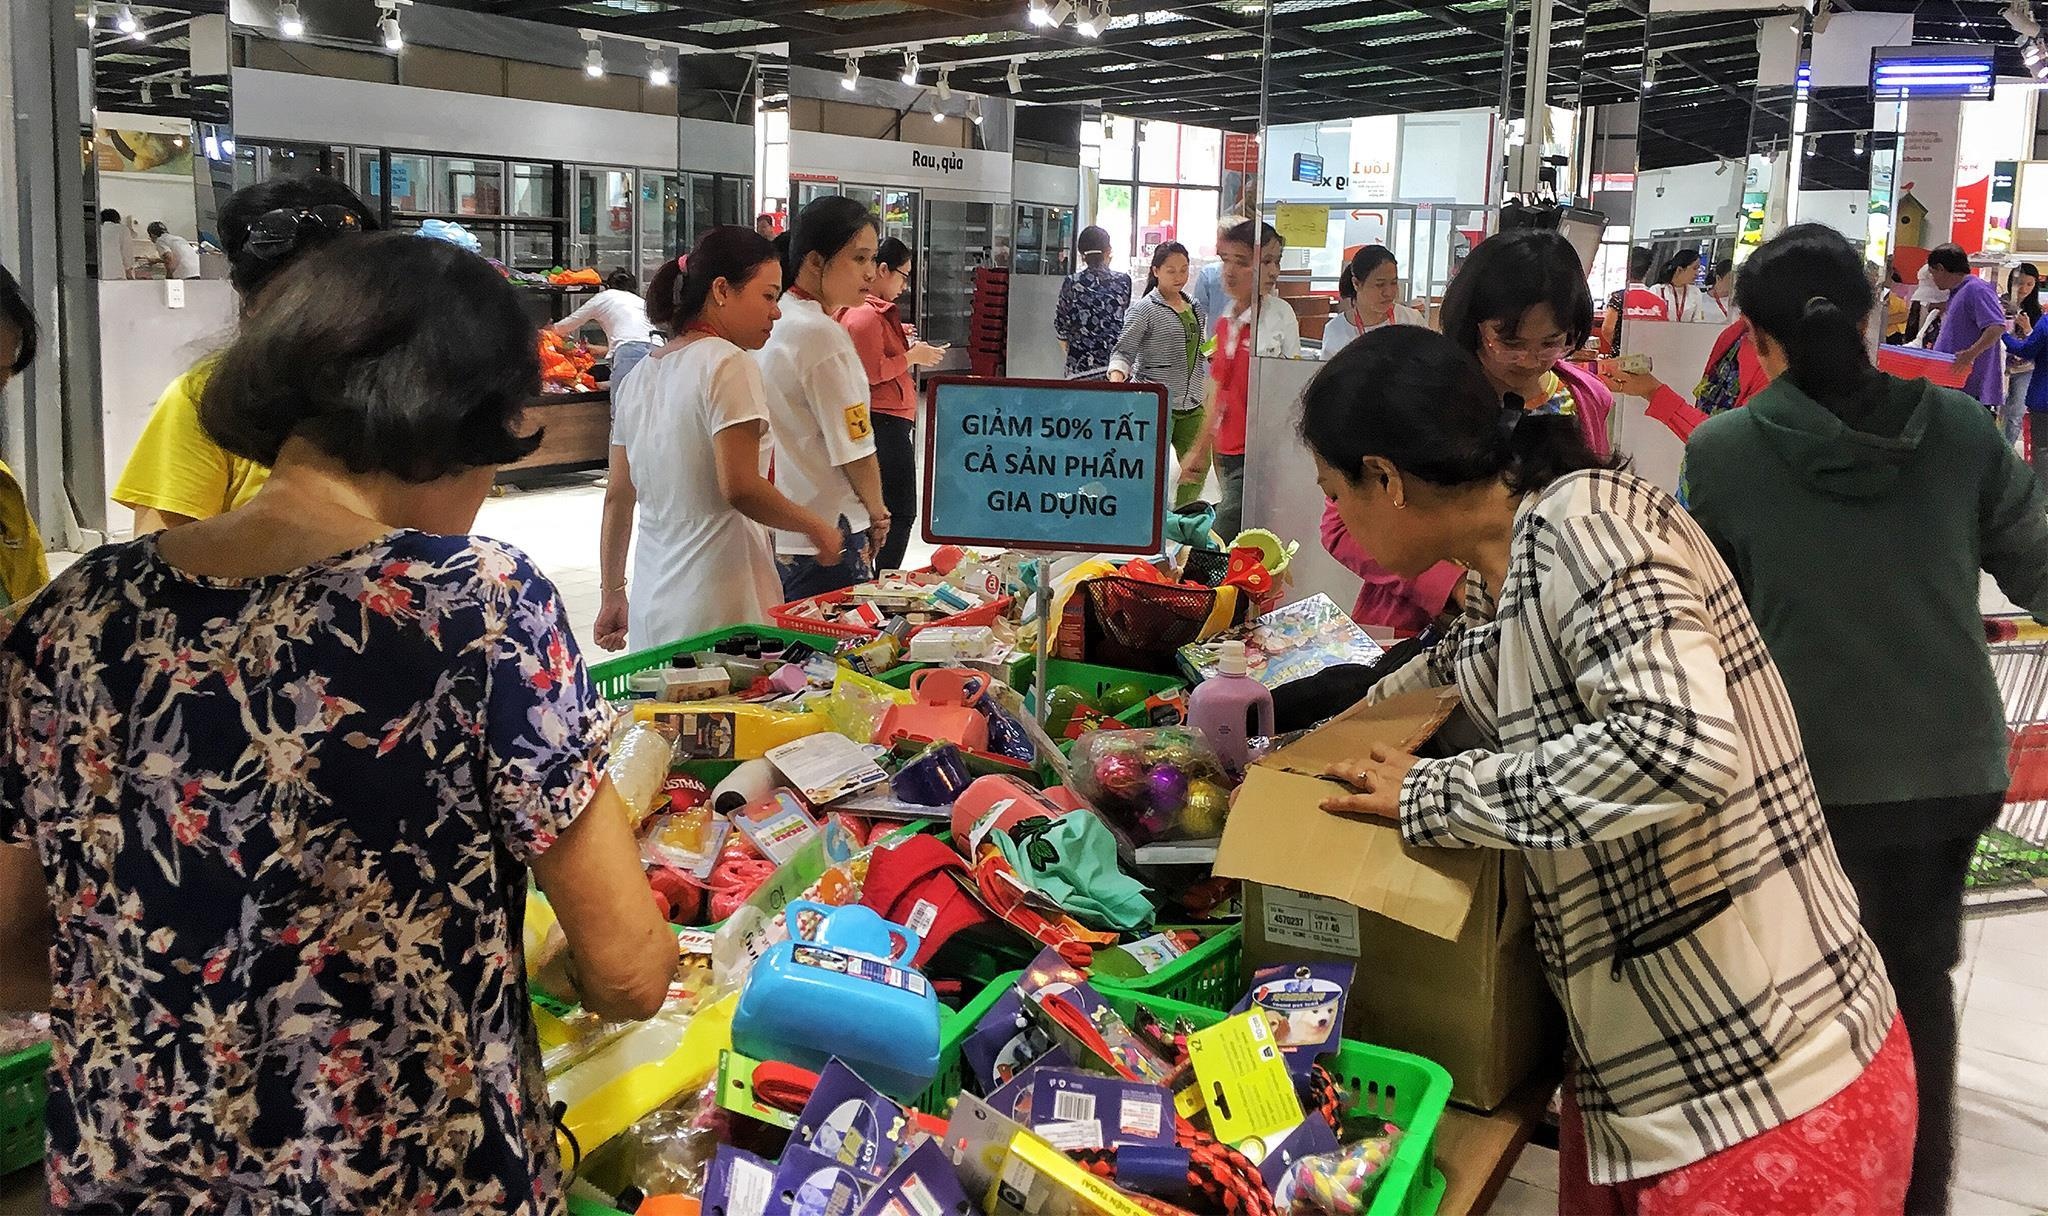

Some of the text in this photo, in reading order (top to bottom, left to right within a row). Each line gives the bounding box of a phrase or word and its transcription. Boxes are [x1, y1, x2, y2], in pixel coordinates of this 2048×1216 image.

[961, 407, 1150, 442] GIẢM 50% TẤT
[964, 444, 1144, 480] CẢ SẢN PHẨM
[987, 490, 1117, 519] GIA DỤNG
[1274, 914, 1304, 927] 4570237
